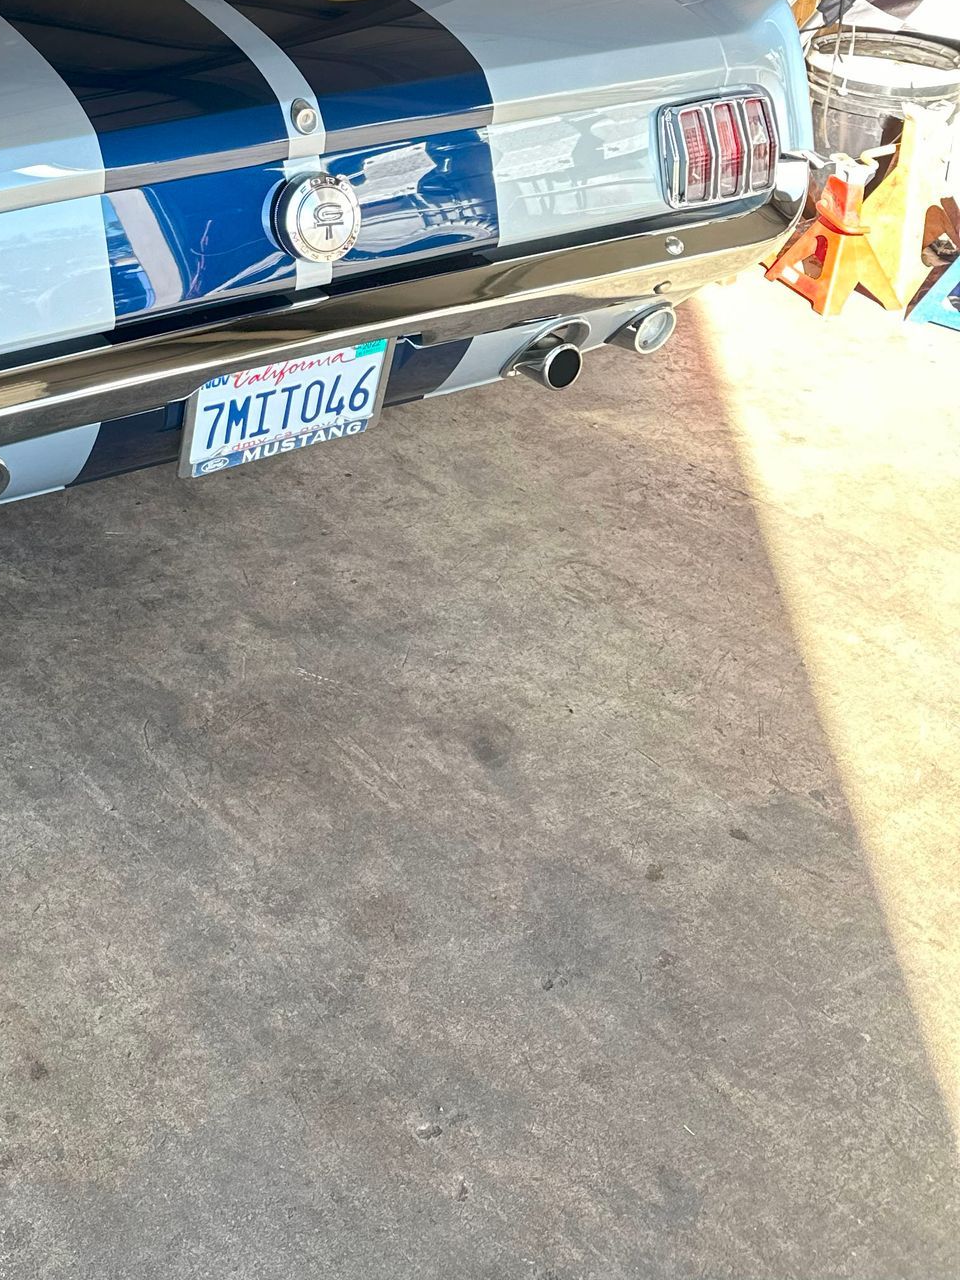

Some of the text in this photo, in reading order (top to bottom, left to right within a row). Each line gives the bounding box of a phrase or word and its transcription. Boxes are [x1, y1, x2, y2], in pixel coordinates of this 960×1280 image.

[234, 351, 356, 389] California
[203, 365, 376, 450] 7MIT046
[241, 421, 362, 464] MUSTANG
